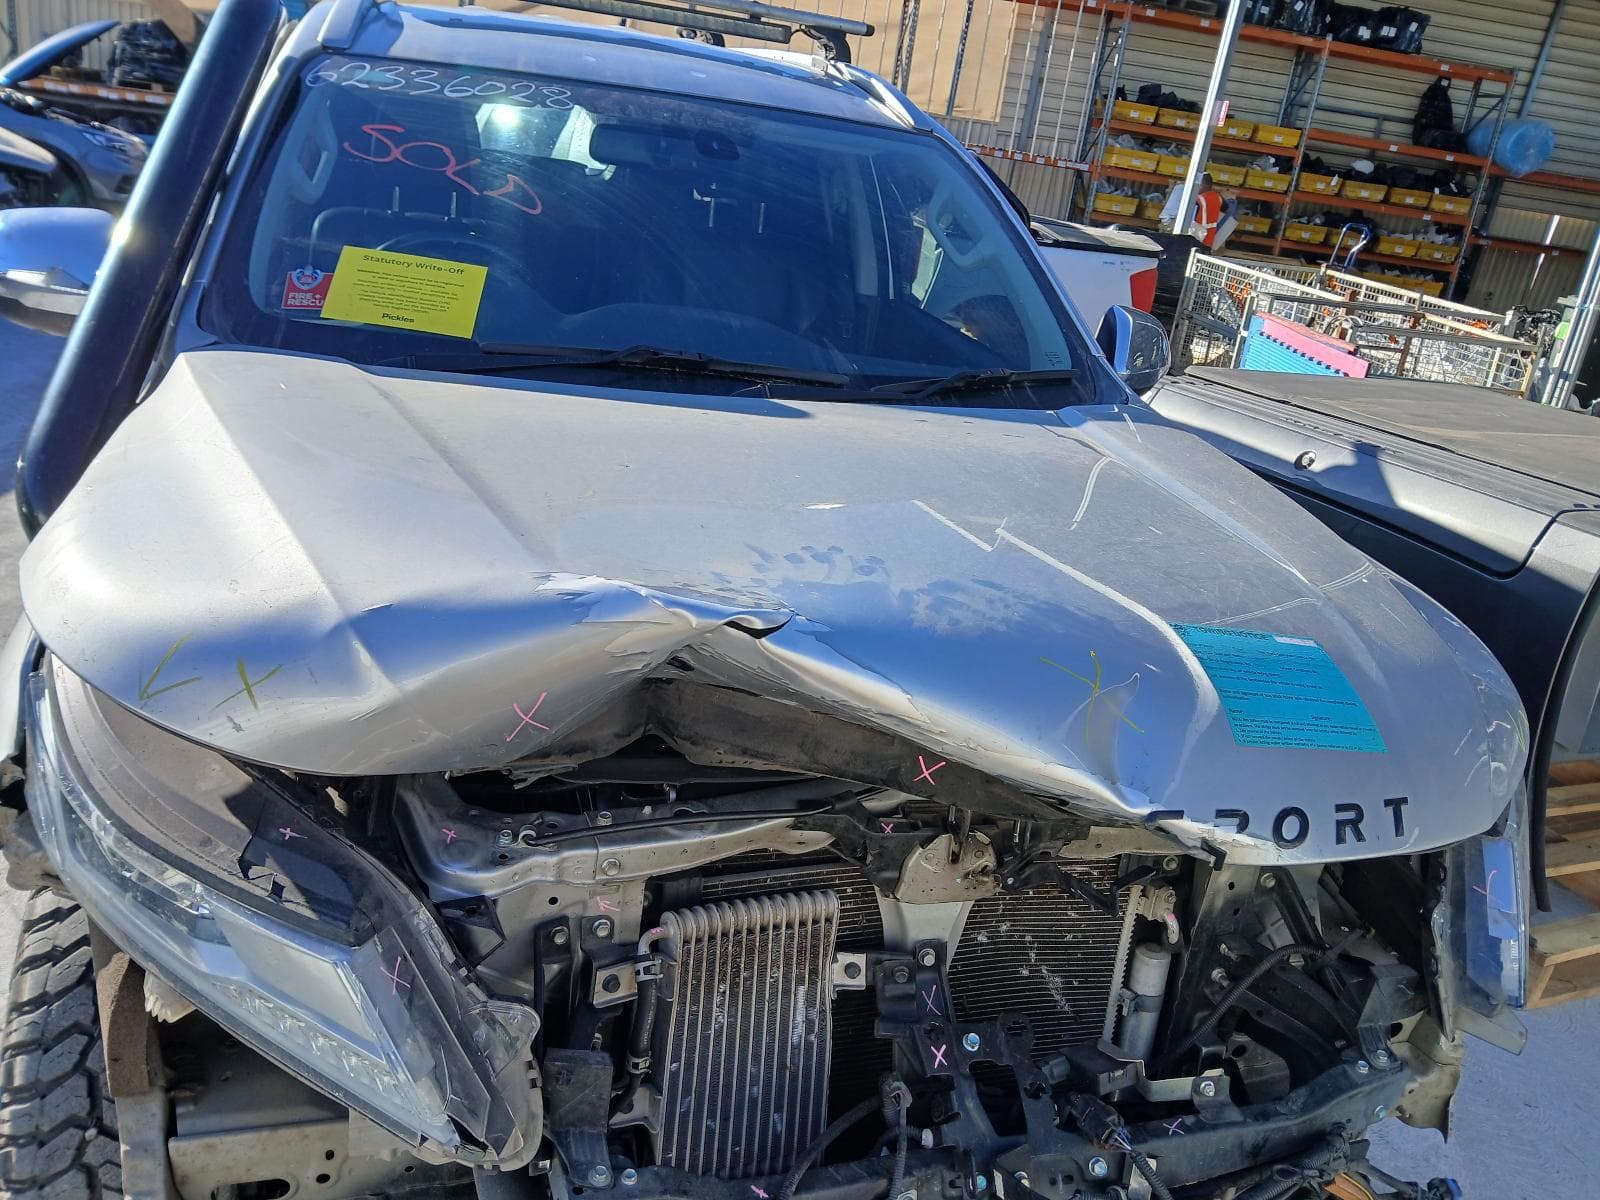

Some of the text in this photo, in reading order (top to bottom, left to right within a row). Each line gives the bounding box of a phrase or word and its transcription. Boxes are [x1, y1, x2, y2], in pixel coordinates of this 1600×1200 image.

[362, 254, 466, 277] Statutory Write-Off
[381, 312, 416, 325] Pickles
